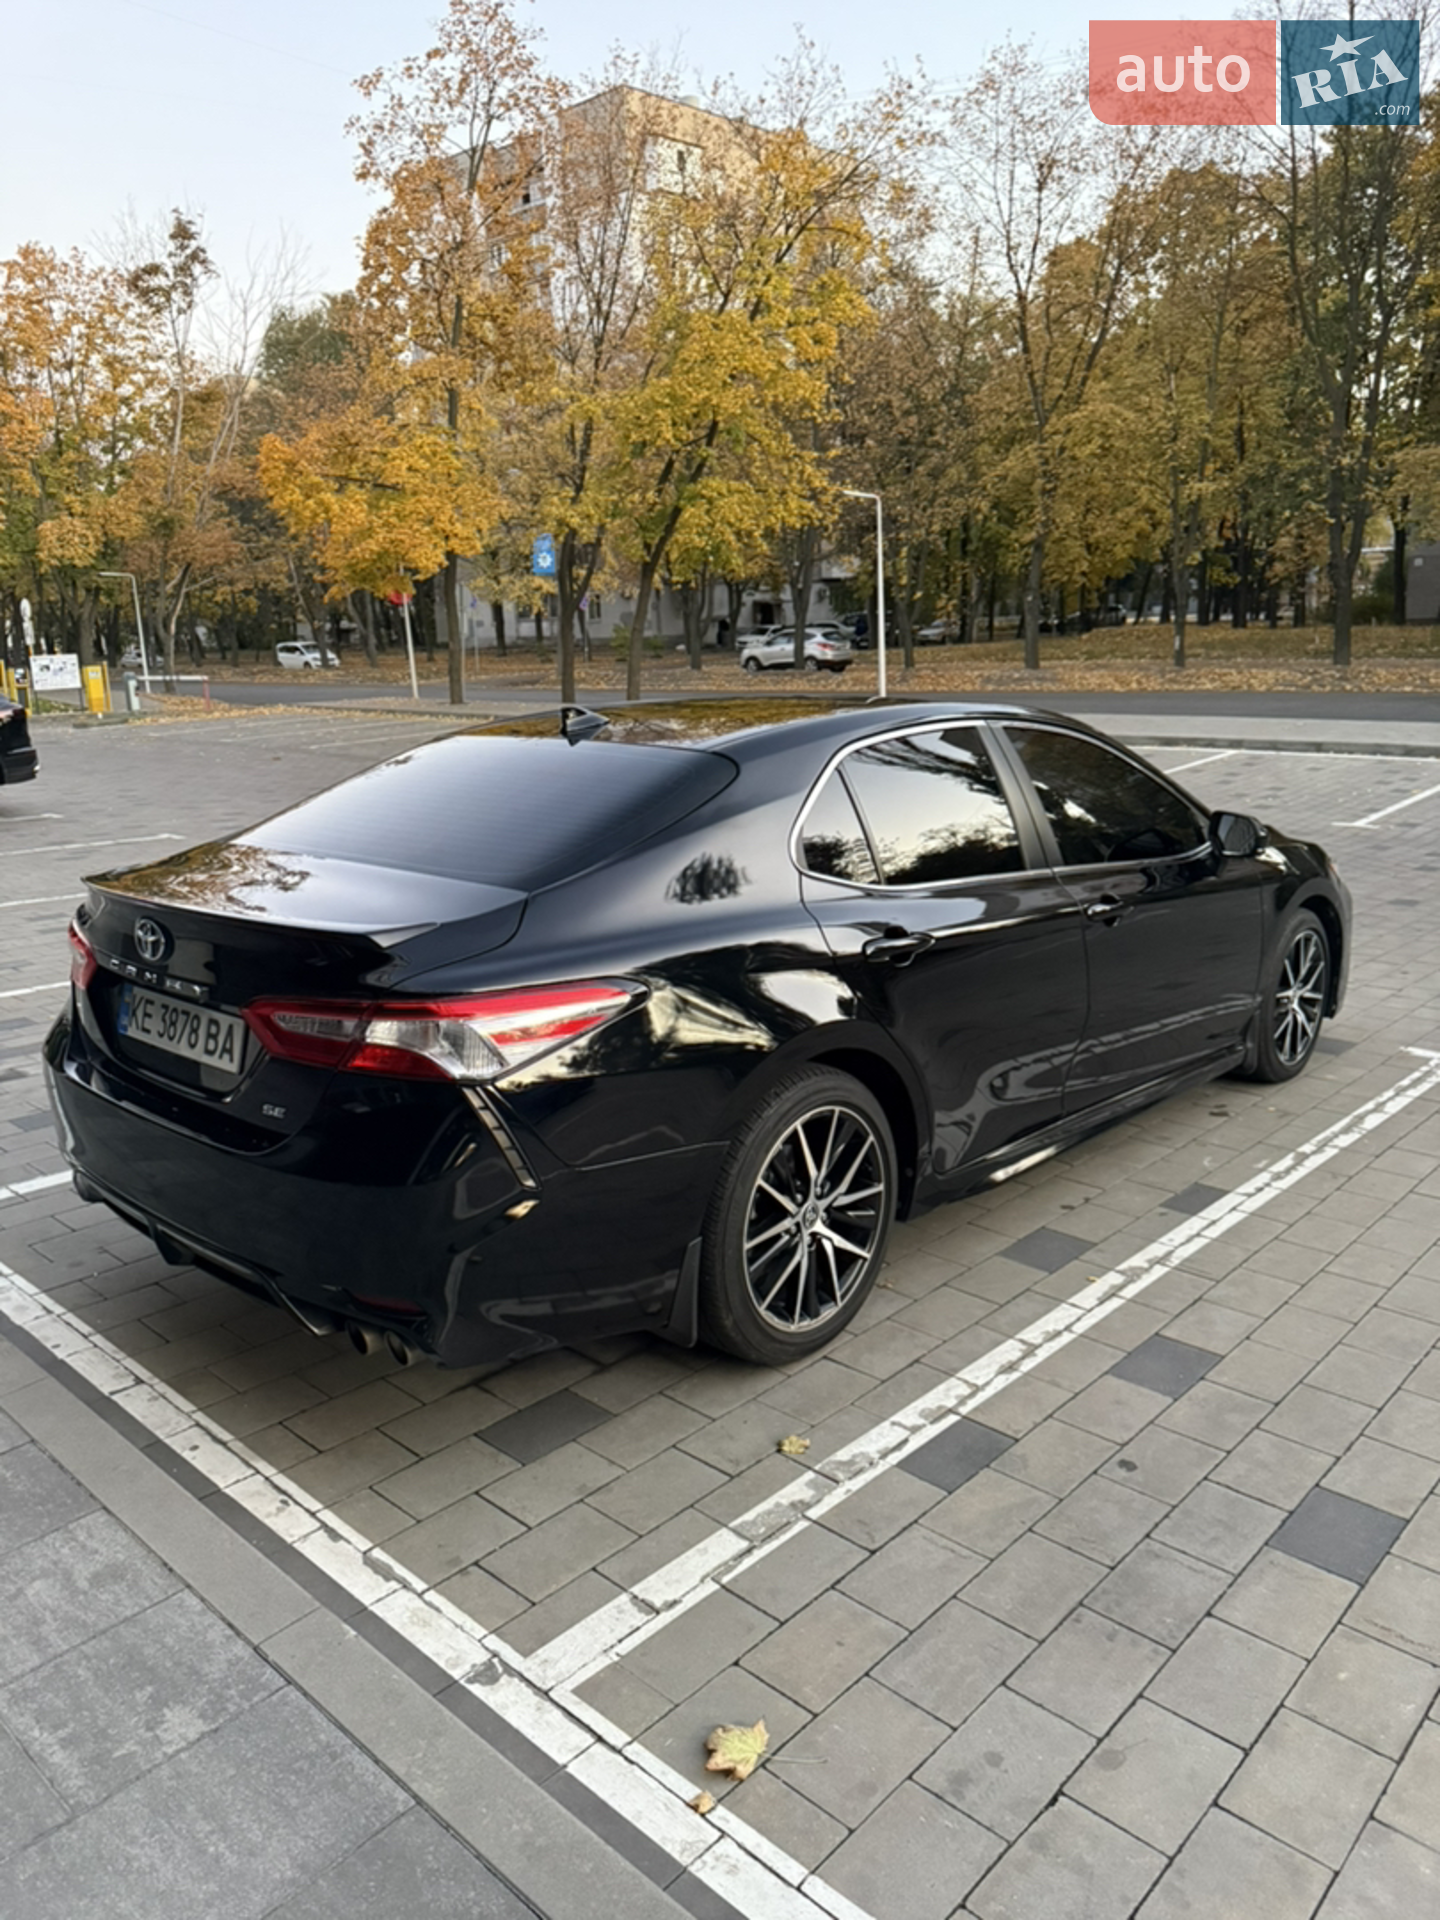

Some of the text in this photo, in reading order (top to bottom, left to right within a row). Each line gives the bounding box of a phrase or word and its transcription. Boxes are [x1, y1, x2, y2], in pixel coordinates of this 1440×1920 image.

[129, 994, 156, 1035] KE
[157, 1003, 201, 1050] 3878
[203, 1018, 235, 1064] BA
[262, 1103, 287, 1119] SE
